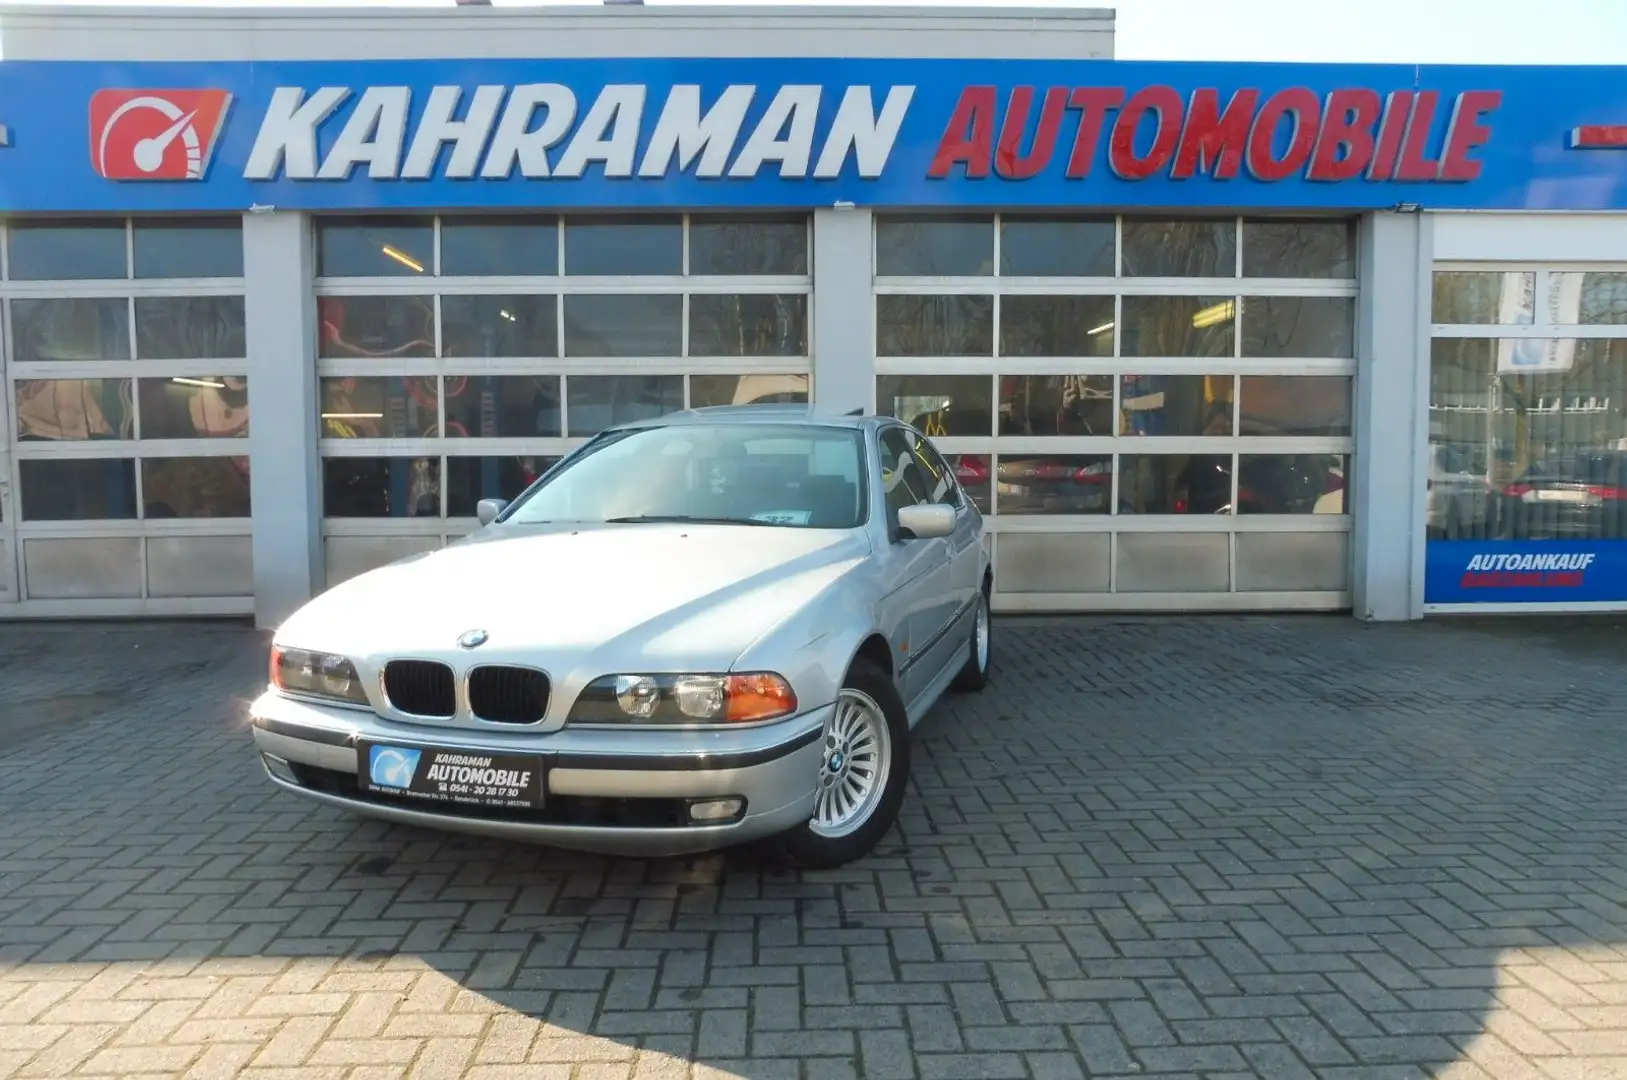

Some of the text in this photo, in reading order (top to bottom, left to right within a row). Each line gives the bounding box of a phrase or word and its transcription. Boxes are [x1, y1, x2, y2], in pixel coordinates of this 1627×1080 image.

[242, 82, 1503, 183] KAHRAMAN AUTOMOBILE
[1466, 553, 1596, 571] AUTOANKAUF
[434, 753, 492, 768] KAHRAMAN
[426, 764, 531, 788] AUTOMOBILE
[450, 784, 469, 793] 0541
[474, 786, 486, 795] 20
[507, 788, 519, 797] 30
